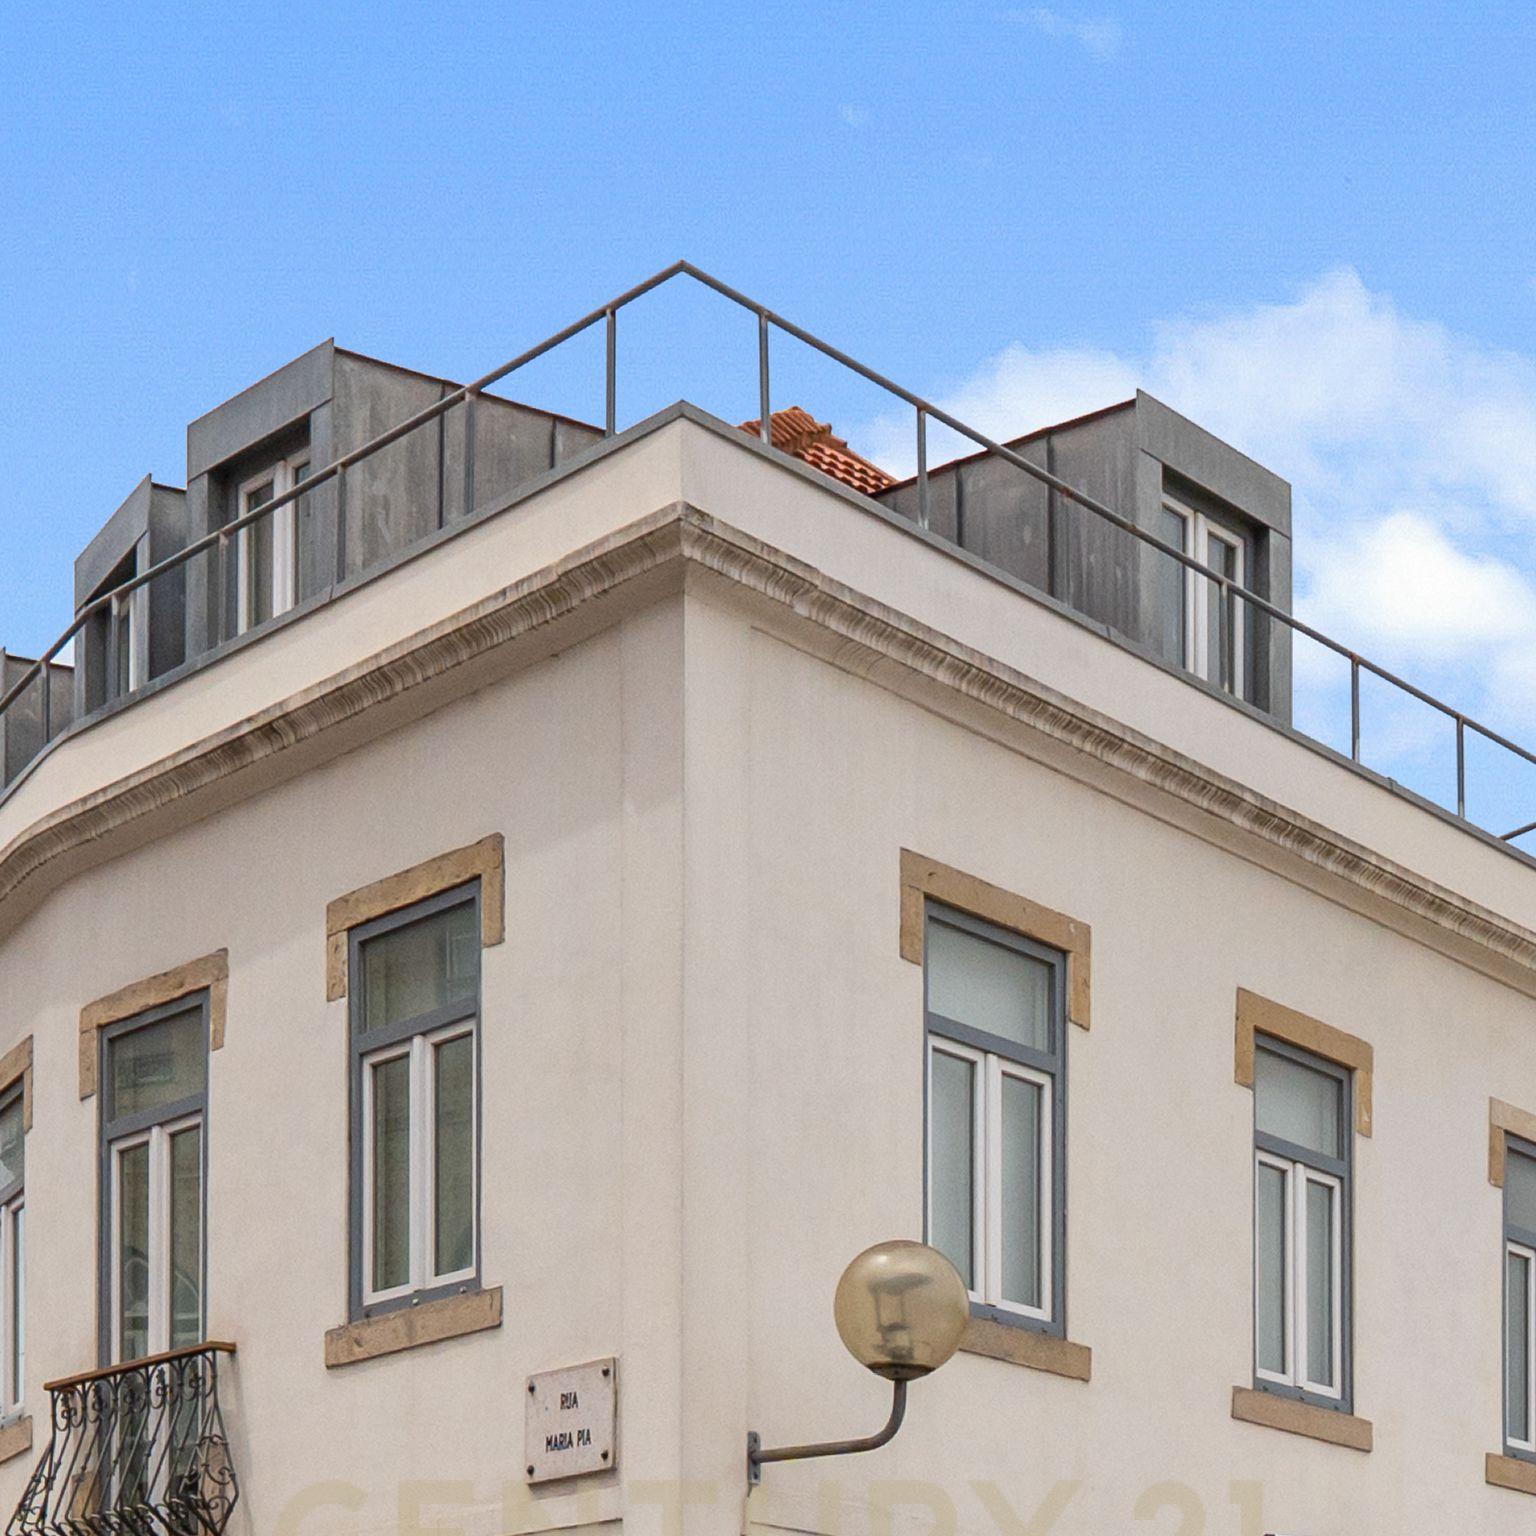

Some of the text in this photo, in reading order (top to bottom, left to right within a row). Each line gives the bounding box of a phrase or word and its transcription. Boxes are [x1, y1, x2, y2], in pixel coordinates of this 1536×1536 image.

[560, 1391, 579, 1410] RUA
[545, 1428, 592, 1453] MARIA PIA
